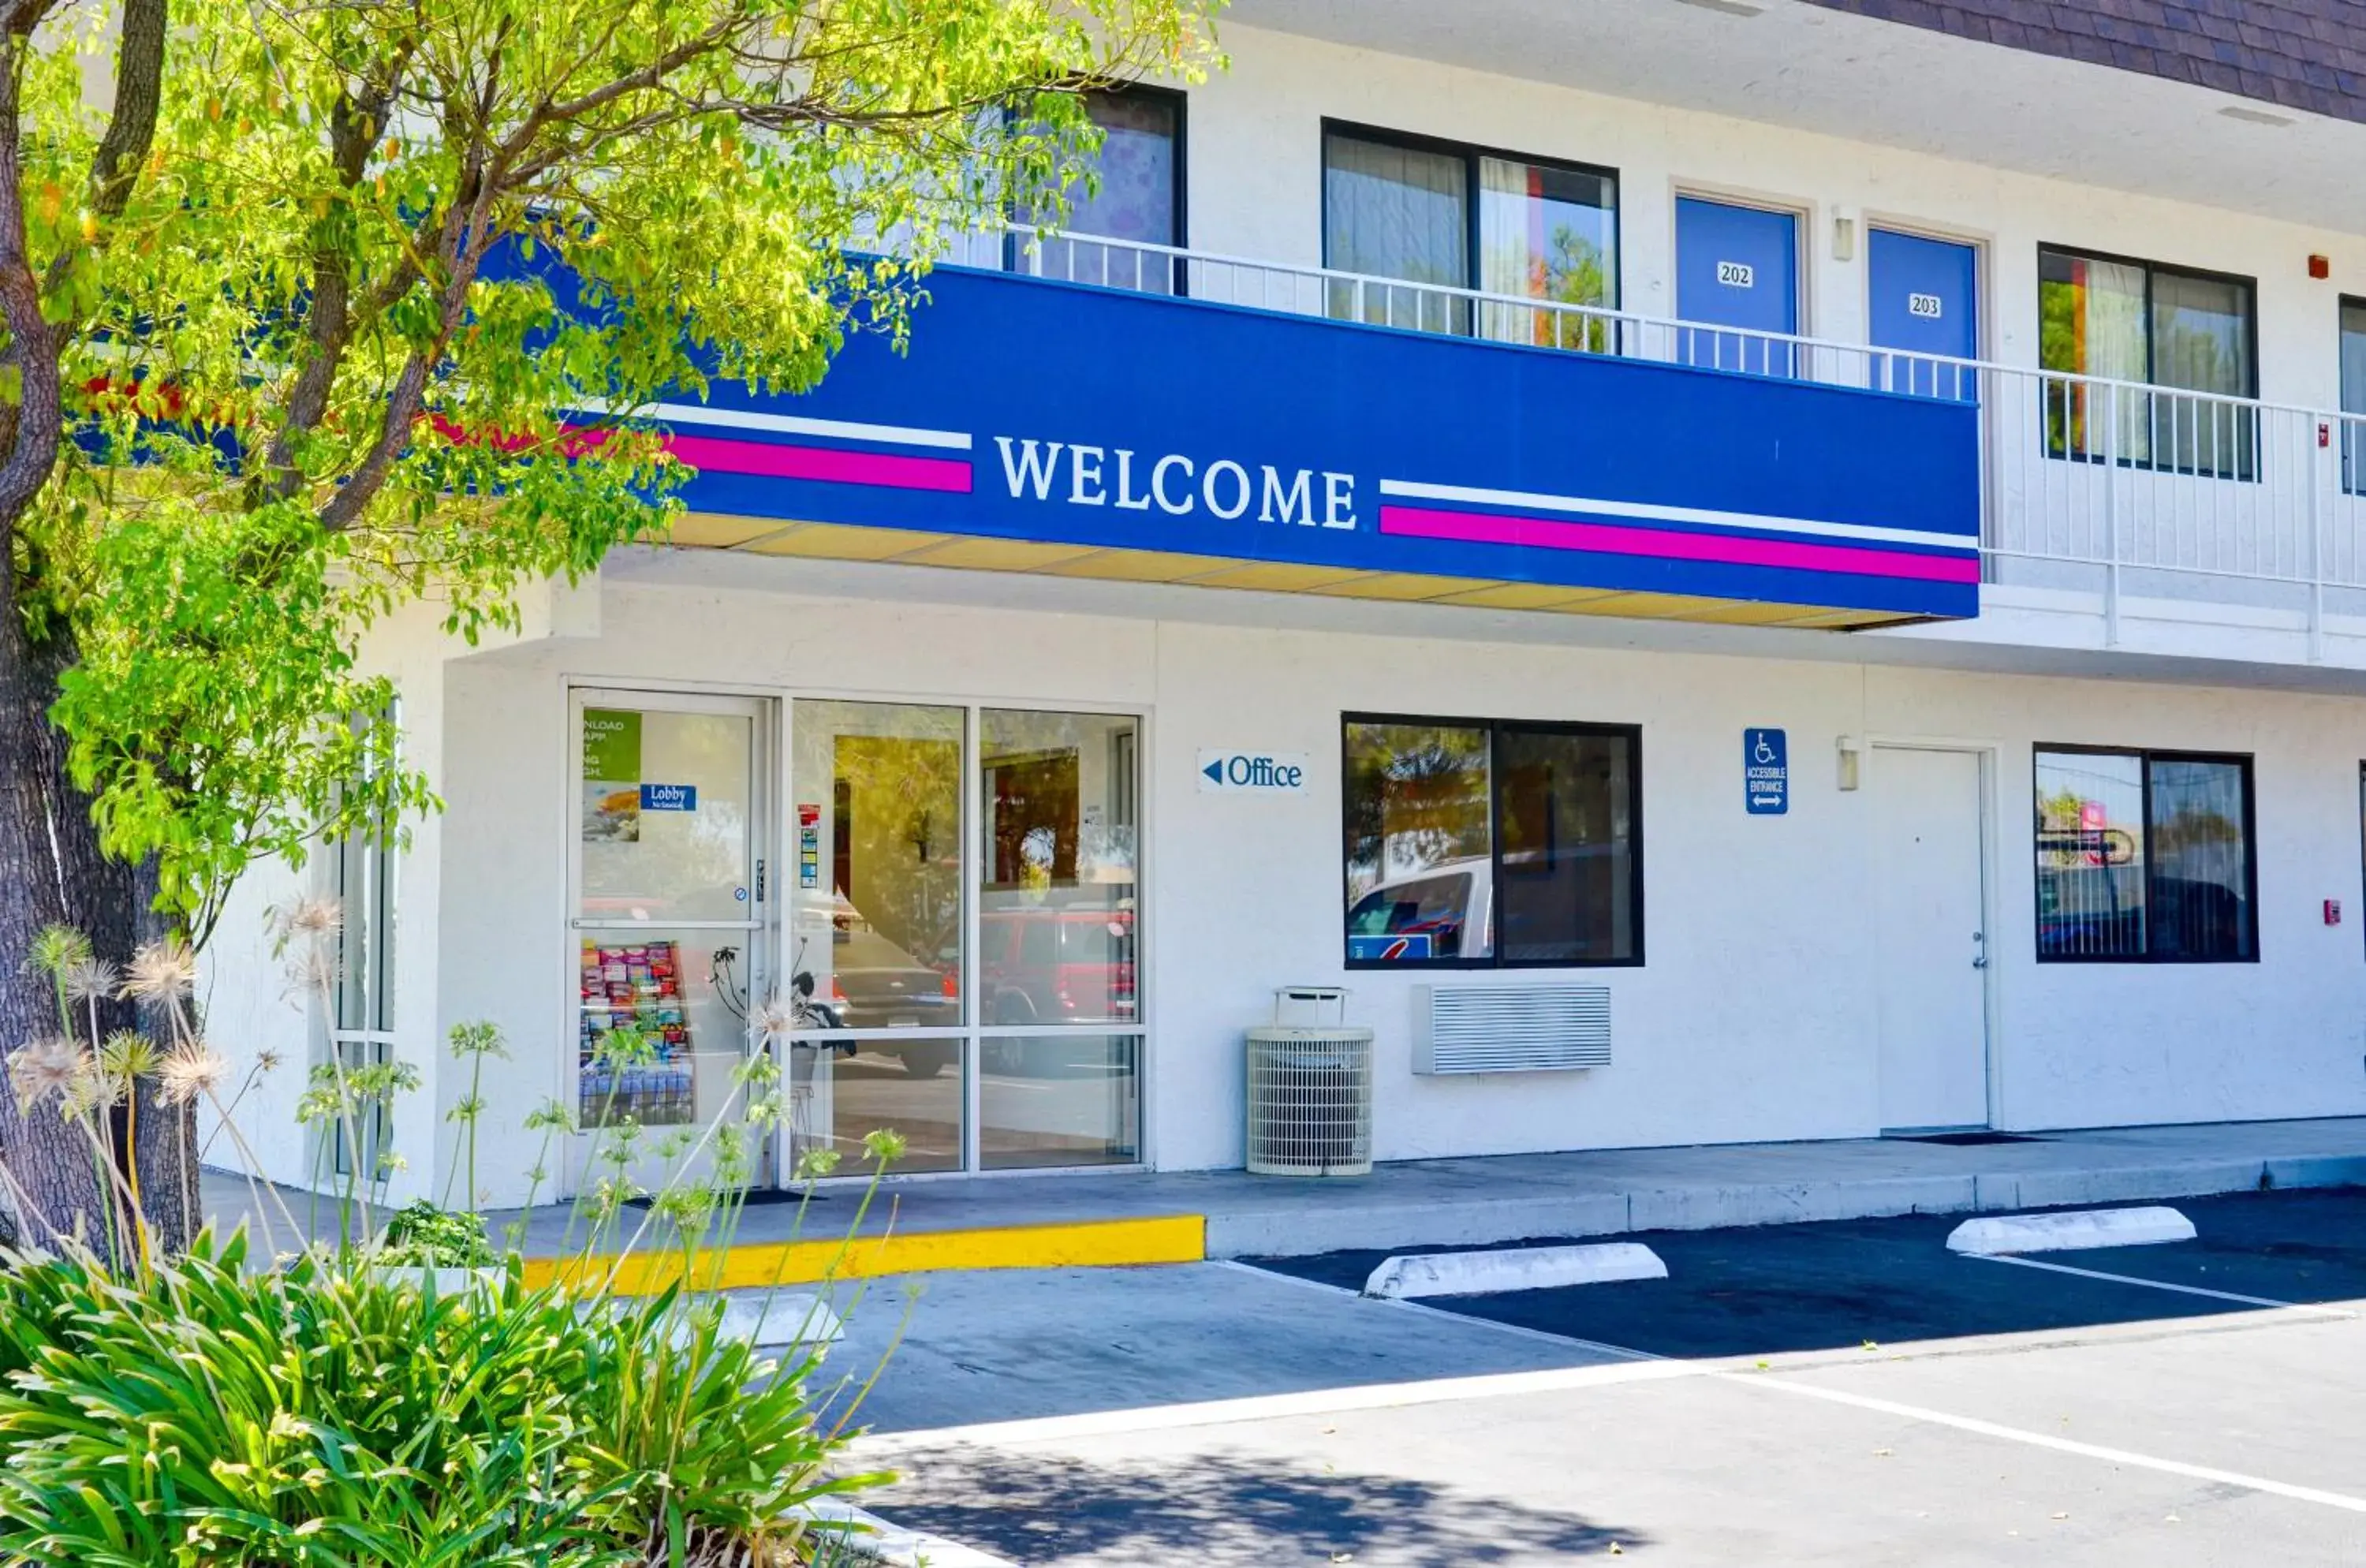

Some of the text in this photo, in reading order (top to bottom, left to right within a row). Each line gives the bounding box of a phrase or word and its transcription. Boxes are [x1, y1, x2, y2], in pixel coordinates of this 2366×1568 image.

[1722, 265, 1749, 284] 202
[1913, 297, 1939, 315] 203
[994, 435, 1357, 530] WELCOME
[1228, 756, 1302, 787] Office
[1747, 767, 1786, 778] ACCESSIBLE
[651, 785, 686, 802] Lobby
[1750, 781, 1783, 793] ENTRANCE
